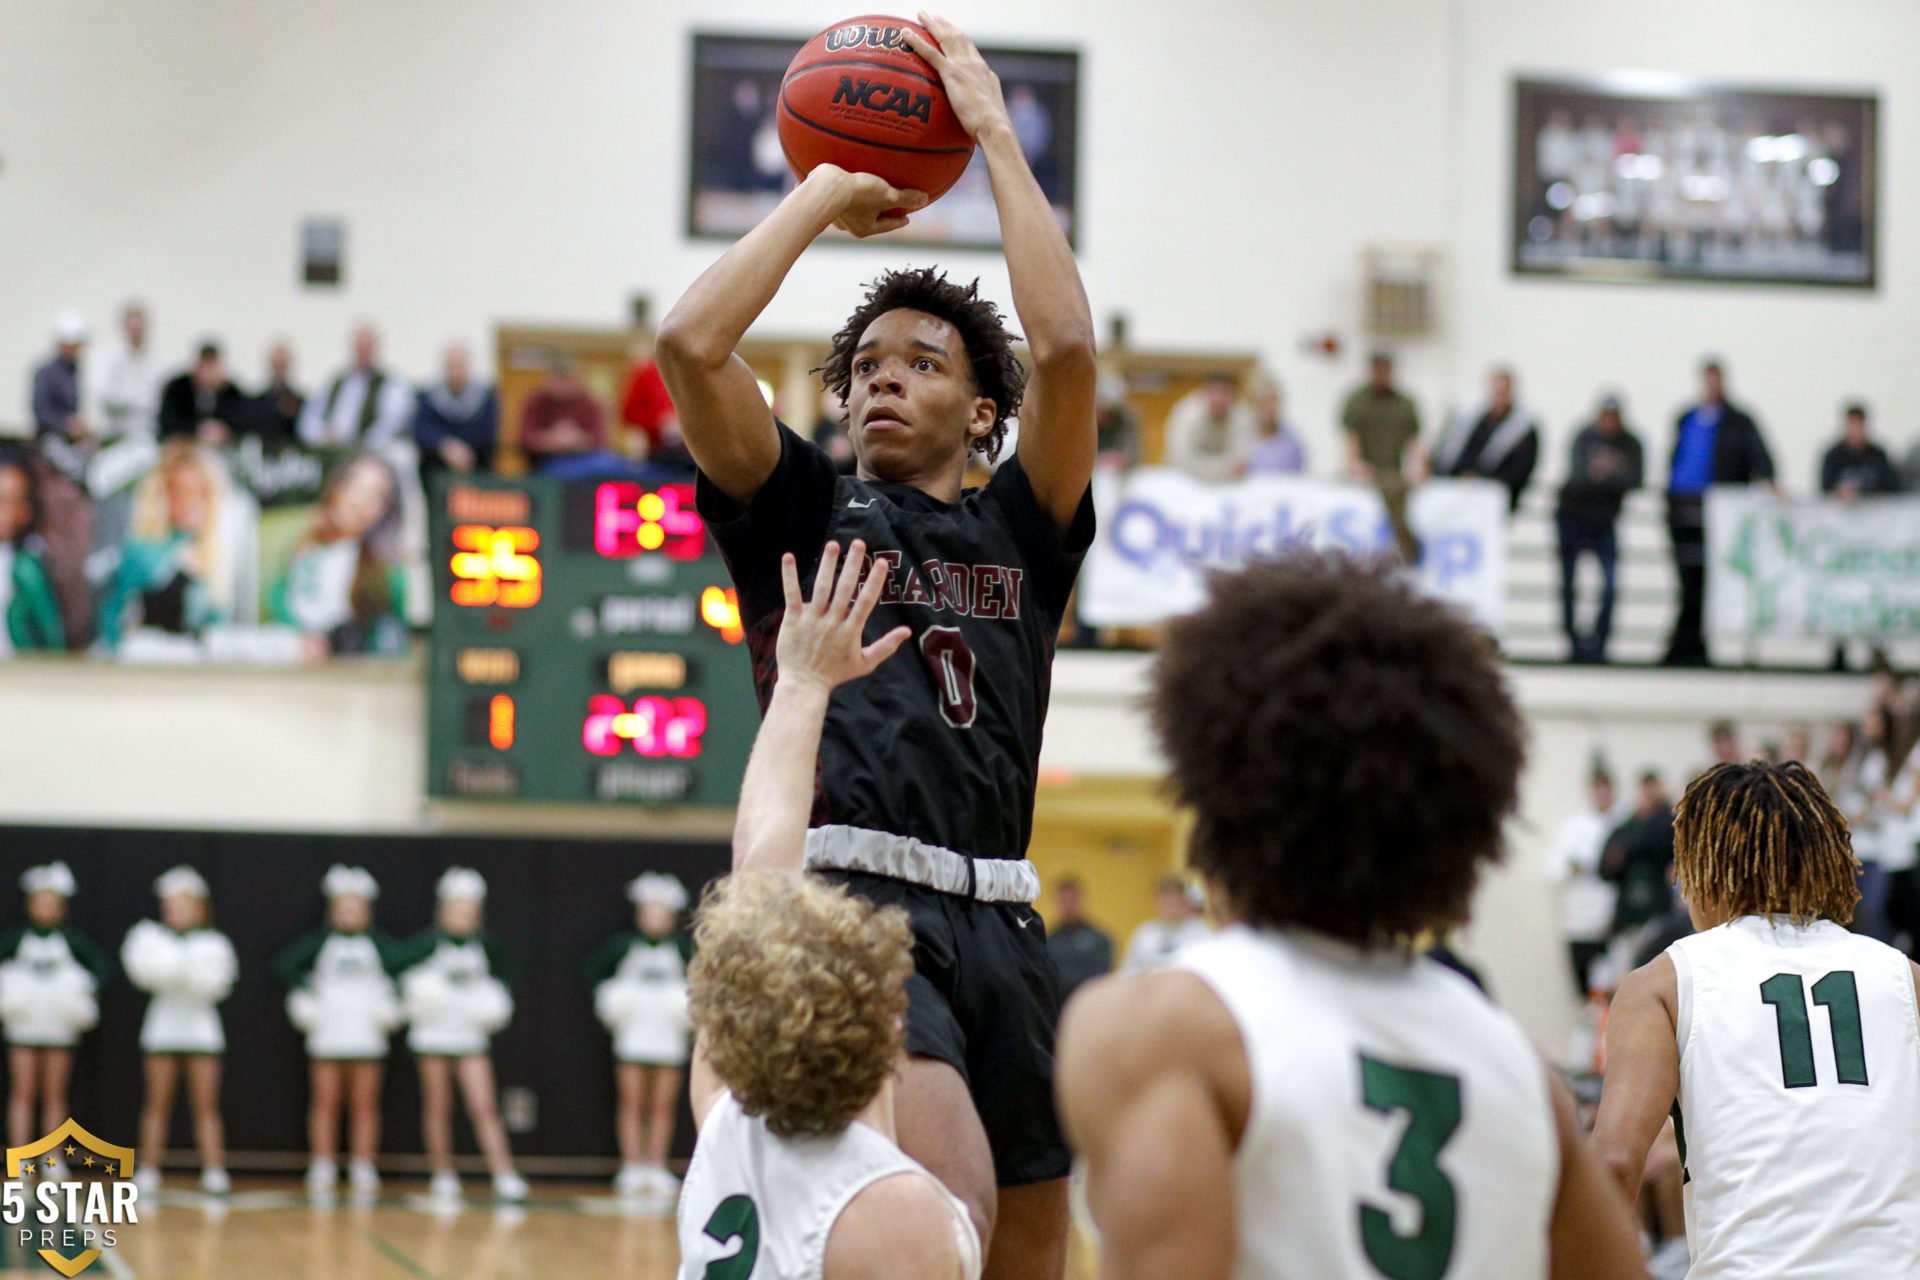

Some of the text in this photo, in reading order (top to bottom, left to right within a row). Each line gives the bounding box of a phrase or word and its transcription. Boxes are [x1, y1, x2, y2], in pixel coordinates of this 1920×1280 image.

[831, 76, 931, 124] NCAA
[450, 525, 542, 608] 35
[919, 625, 977, 728] 0
[1759, 970, 1869, 1089] 11
[1358, 1052, 1461, 1280] 3
[702, 1194, 760, 1280] 2
